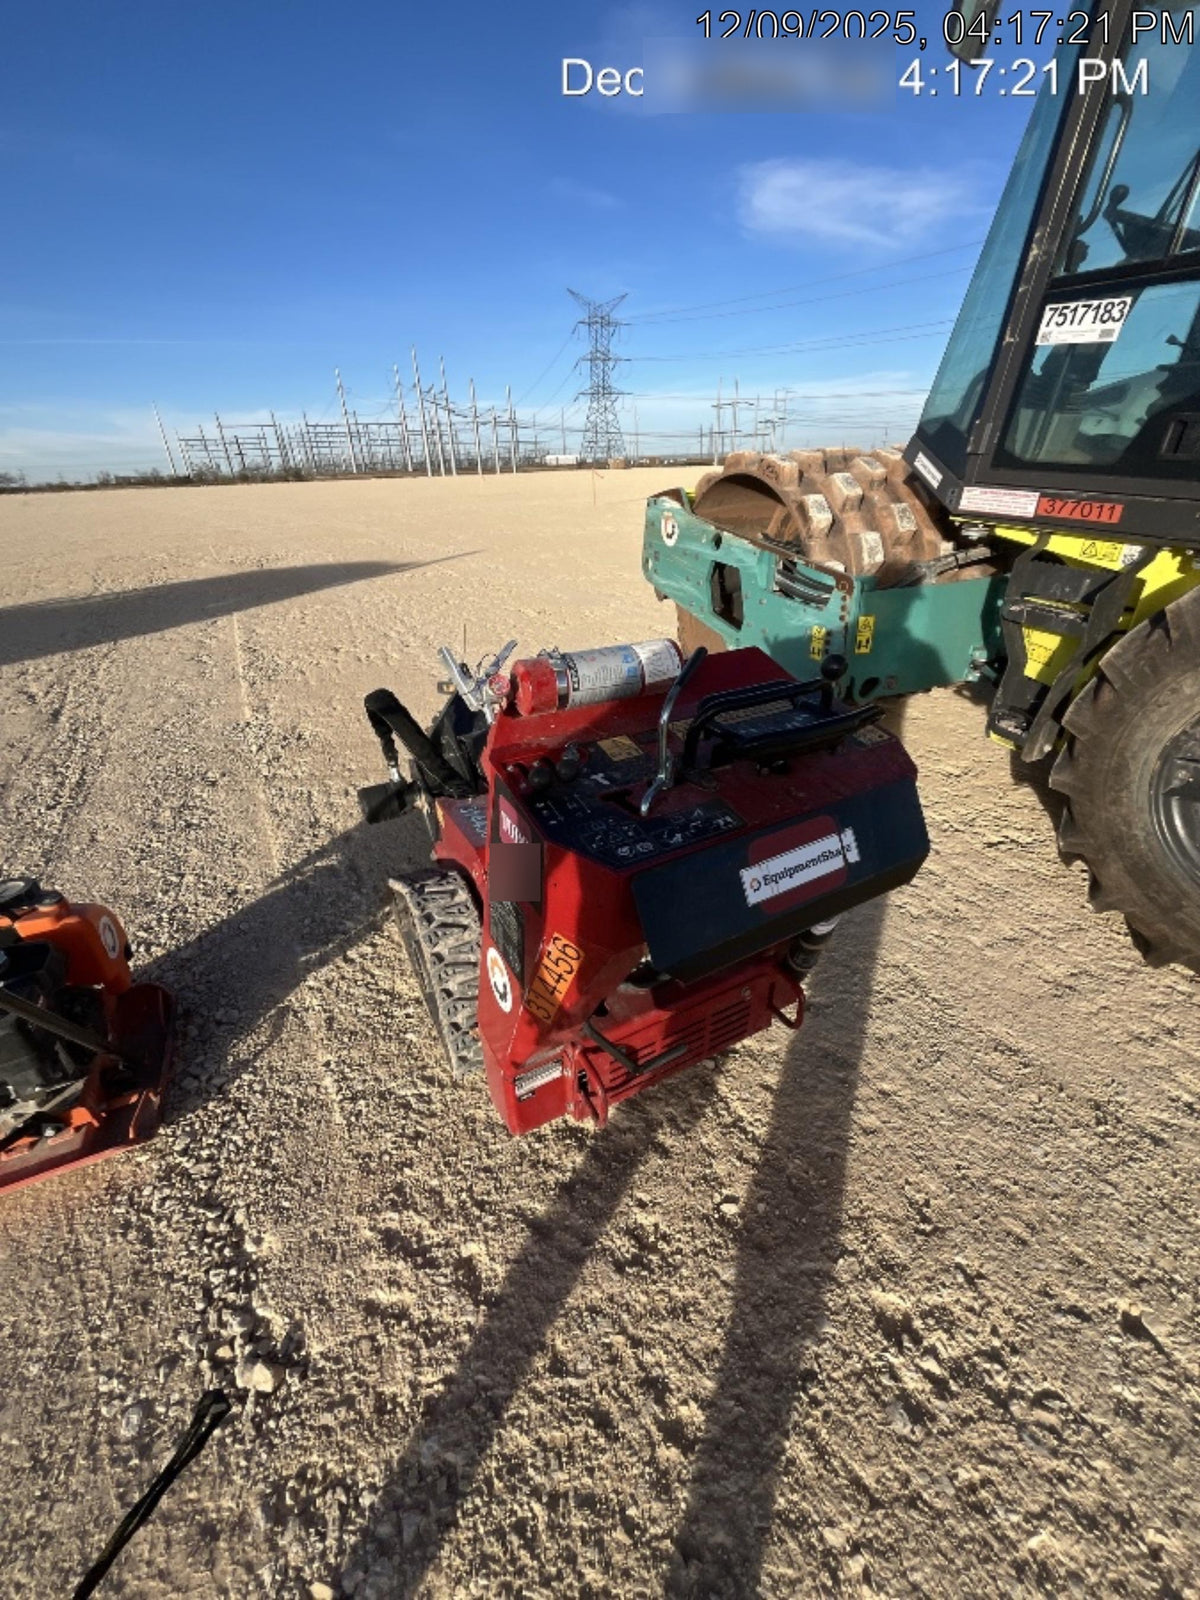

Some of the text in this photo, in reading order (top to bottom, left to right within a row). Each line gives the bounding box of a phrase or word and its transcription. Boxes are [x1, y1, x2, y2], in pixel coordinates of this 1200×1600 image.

[1045, 300, 1125, 327] 7517183
[1045, 499, 1118, 520] 377011
[526, 936, 581, 1021] 314456
